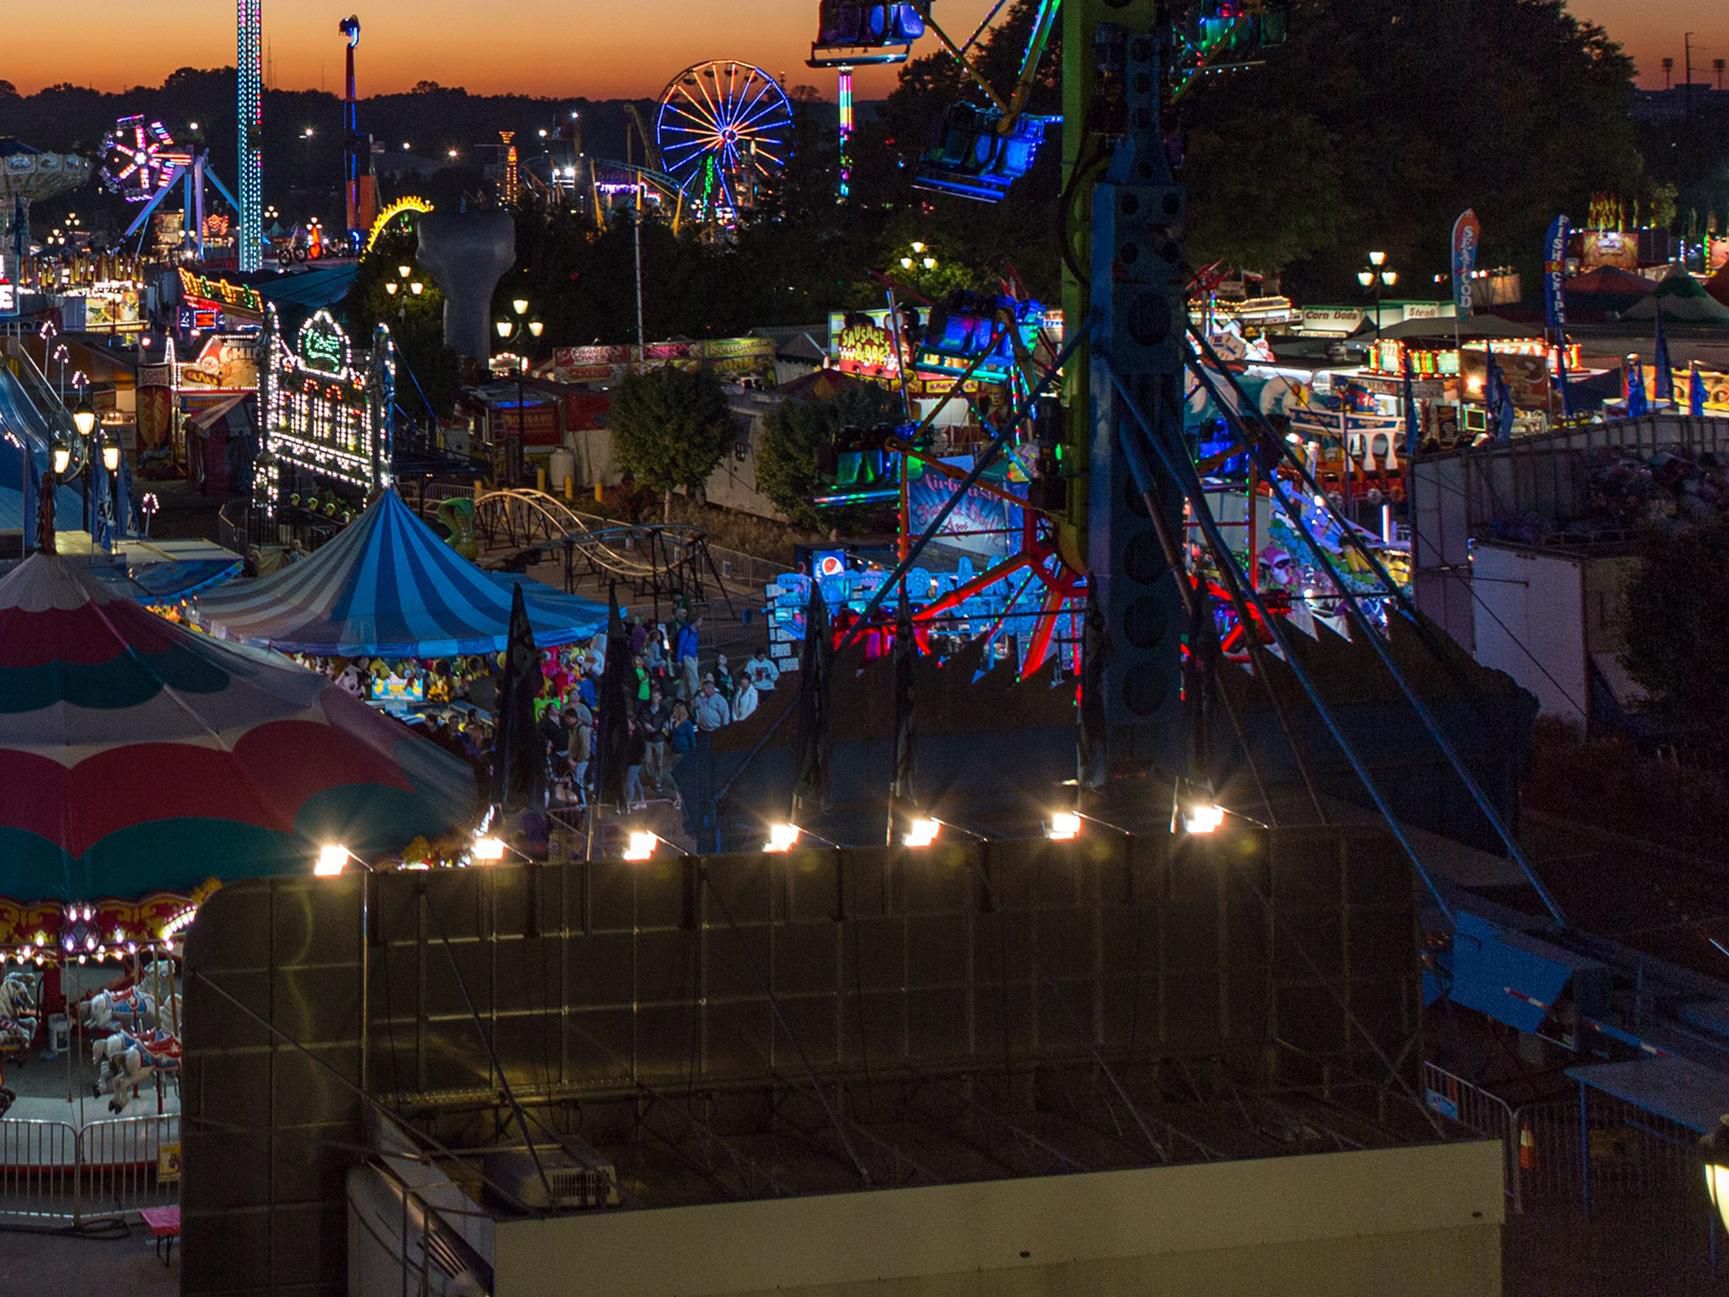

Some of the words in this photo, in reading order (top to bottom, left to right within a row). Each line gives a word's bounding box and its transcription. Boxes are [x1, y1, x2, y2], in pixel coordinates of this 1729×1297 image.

[1306, 311, 1329, 320] Corn
[1408, 306, 1437, 317] Steak
[842, 325, 886, 347] SAUSAGE
[864, 341, 891, 365] DOGS
